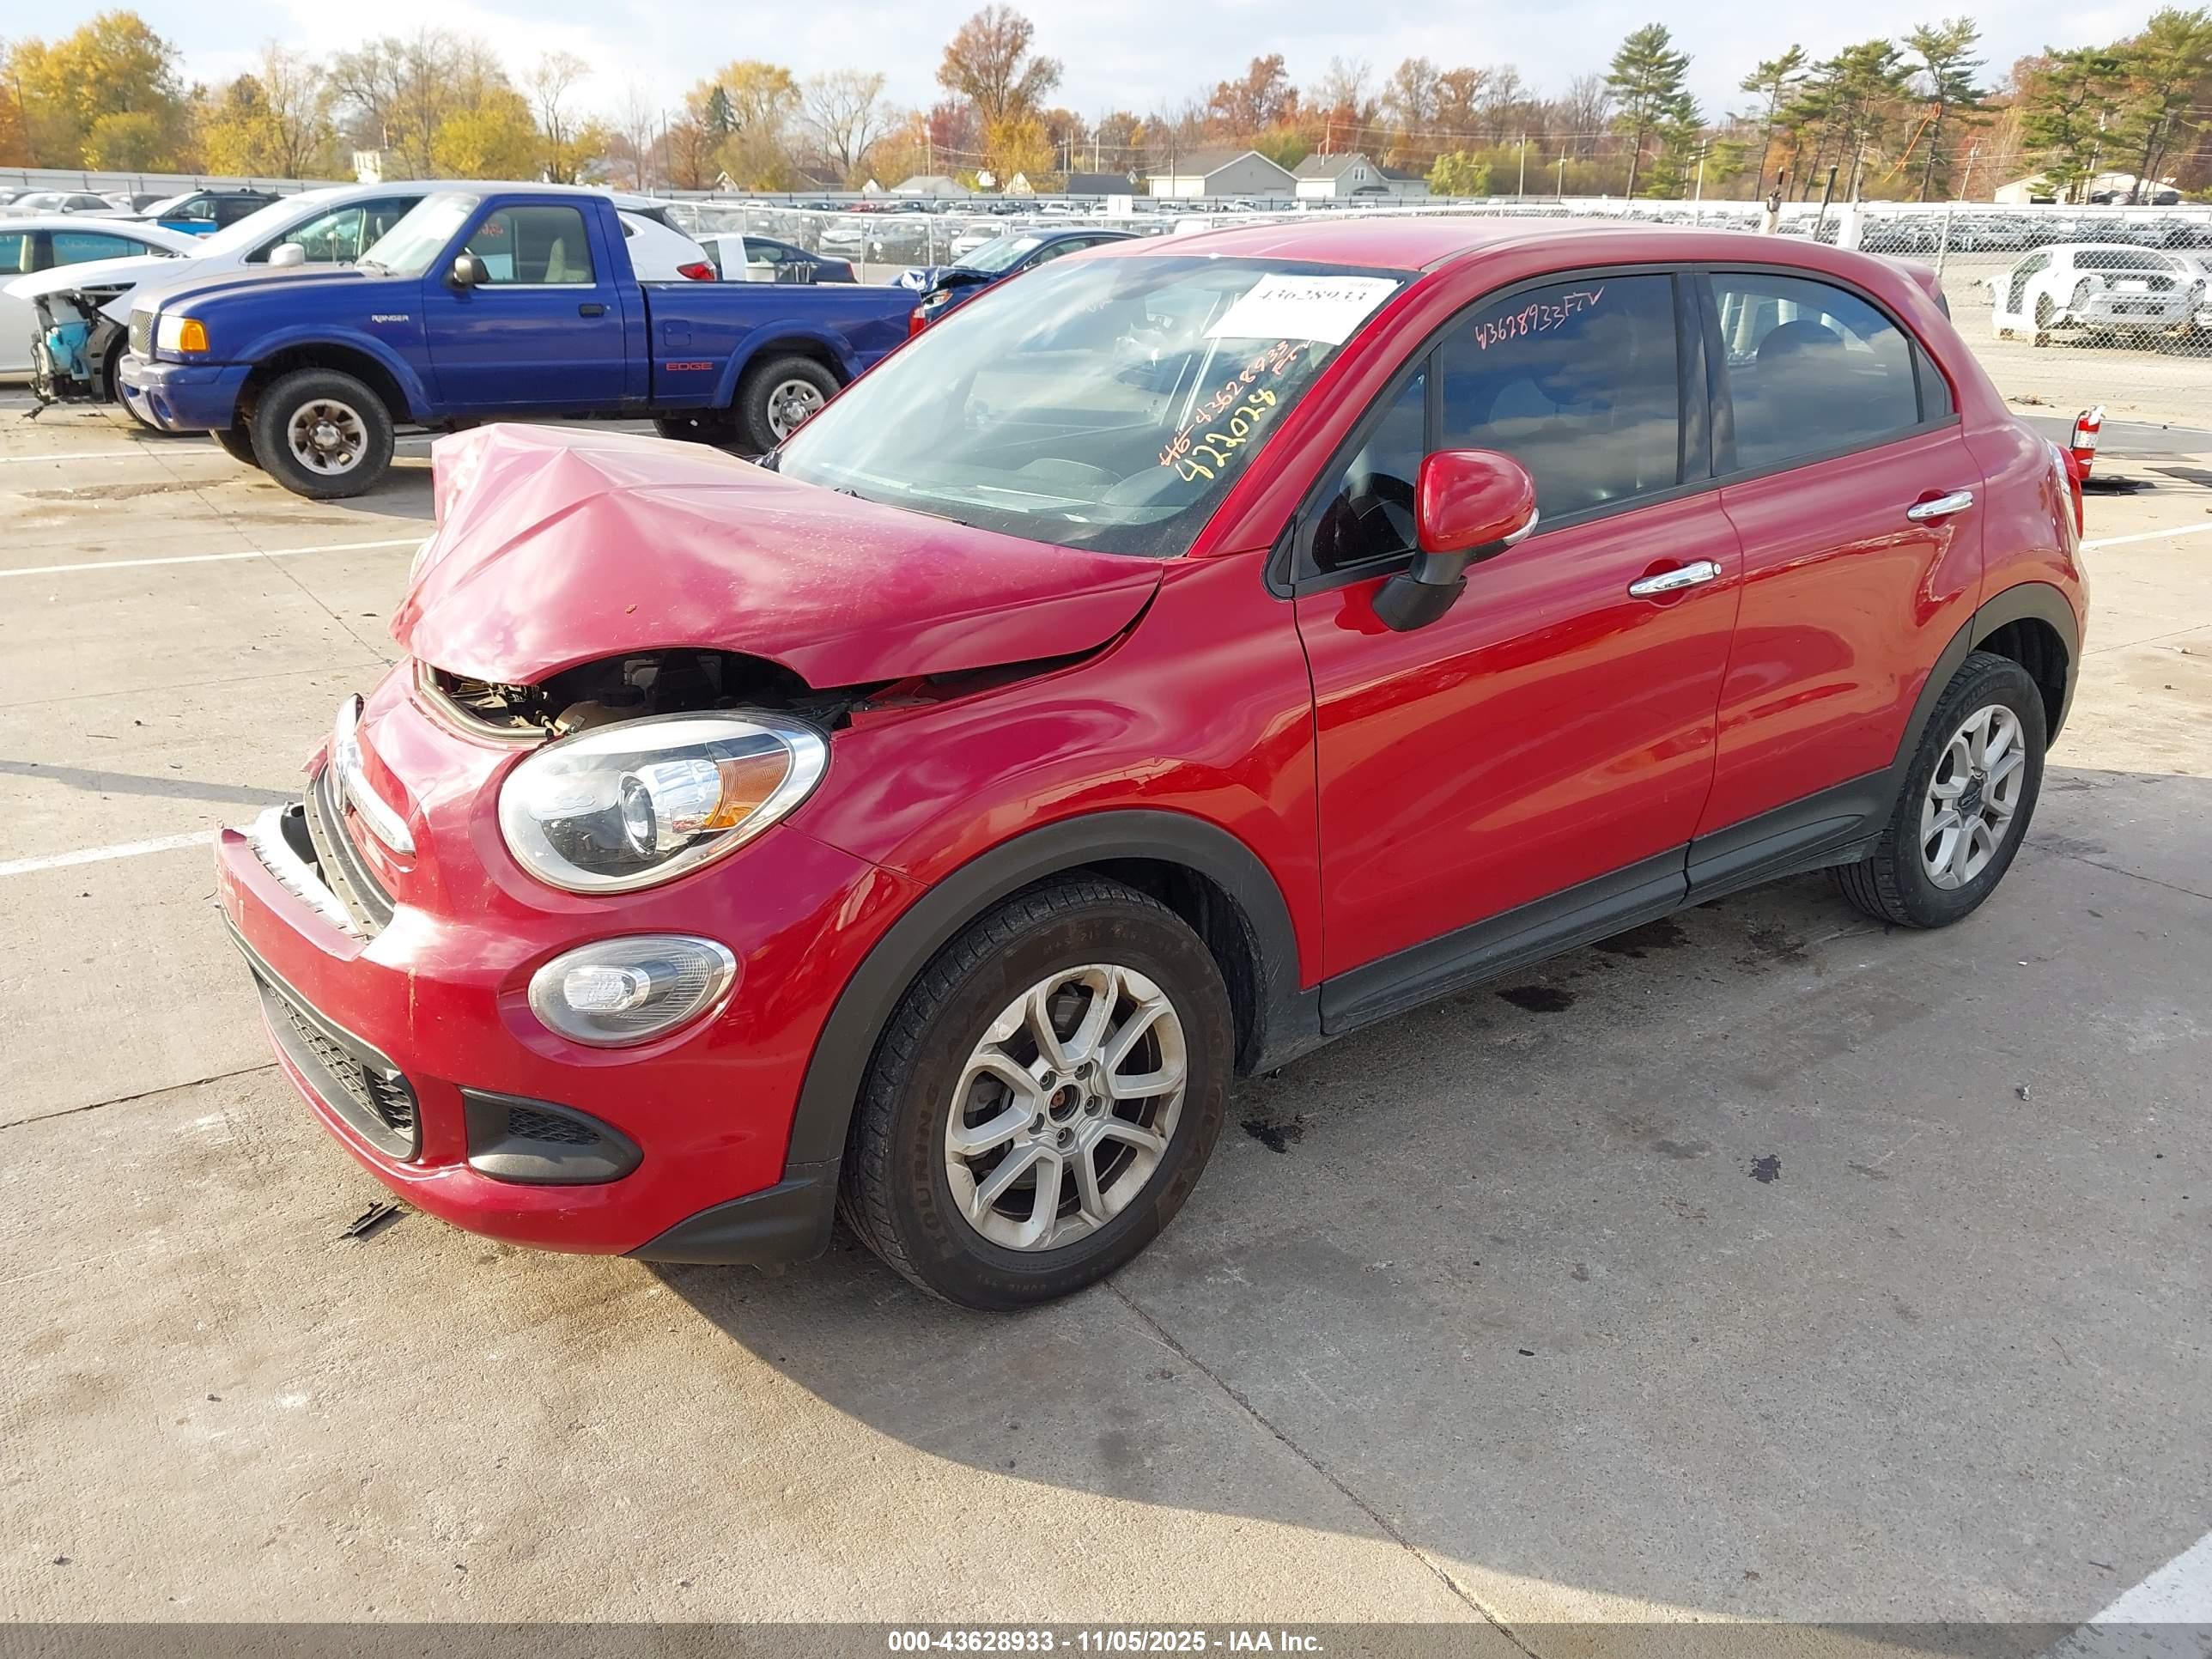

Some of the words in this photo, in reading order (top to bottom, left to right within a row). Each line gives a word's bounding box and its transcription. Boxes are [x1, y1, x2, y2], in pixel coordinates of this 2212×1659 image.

[371, 314, 409, 324] RANGER
[665, 362, 714, 371] EDGE
[1175, 388, 1277, 482] 422028
